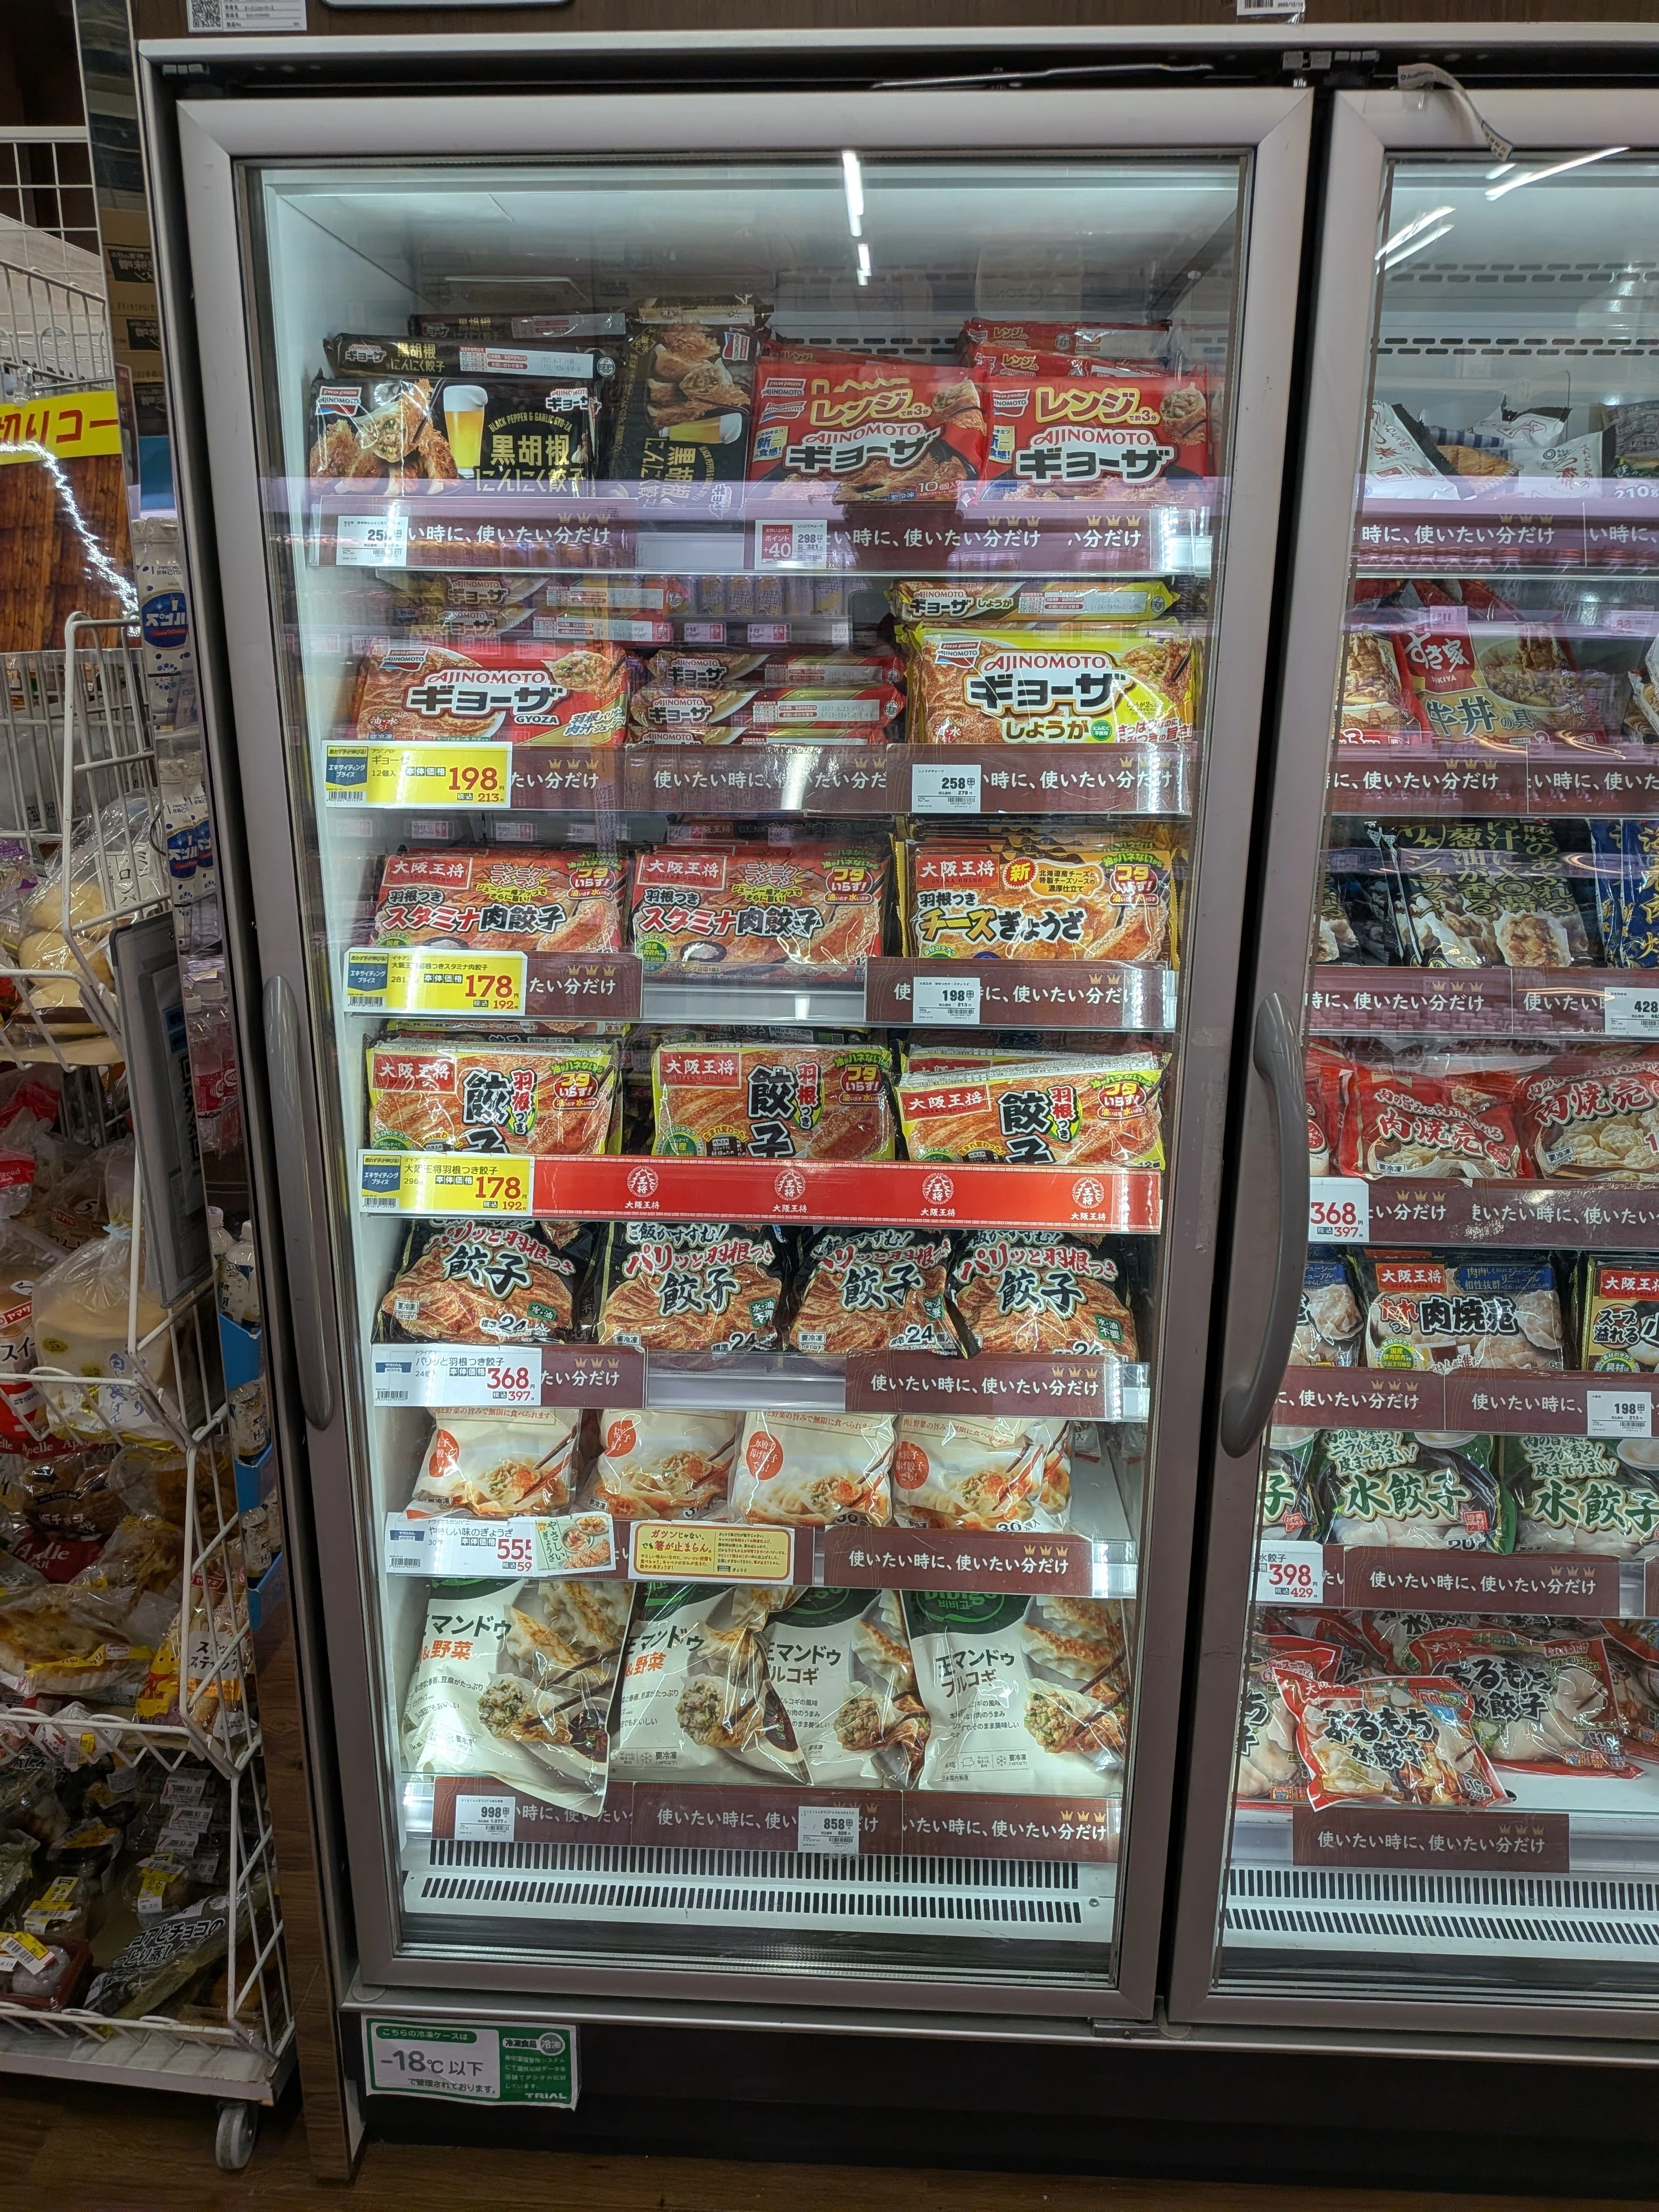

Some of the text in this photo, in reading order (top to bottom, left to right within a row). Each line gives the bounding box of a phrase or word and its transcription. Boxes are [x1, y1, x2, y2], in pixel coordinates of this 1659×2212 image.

[397, 342, 437, 360] 黒胡椒
[390, 359, 445, 373] にんにく餃子
[814, 391, 908, 425] レンジ
[900, 404, 930, 416] で約3分
[1040, 390, 1135, 422] レンジ
[488, 412, 573, 433] BLACK PEPPER & GARLIC GYO-ZA
[1128, 409, 1157, 421] で約3分
[805, 424, 921, 444] AJINOMOTO
[1034, 429, 1152, 446] AJINOMOTO
[490, 434, 570, 466] 黒胡椒
[789, 431, 937, 470] ギョーザ
[1020, 447, 1170, 480] ギョーザ
[475, 468, 586, 497] にんにく餃子
[798, 534, 816, 543] 298
[763, 542, 791, 557] +40
[977, 597, 1013, 608] しょうが
[1405, 630, 1470, 673] すき家
[984, 655, 1108, 672] AJINOMOTO
[428, 670, 545, 684] AJINOMOTO
[1431, 675, 1457, 683] SUKIYA
[410, 685, 564, 712] ギョーザ
[969, 674, 1127, 708] ギョーザ
[515, 715, 559, 724] GYOZA
[1426, 694, 1535, 738] 牛丼の具
[1004, 719, 1089, 740] しょうが
[448, 766, 498, 790] 198
[941, 777, 966, 789] 258
[478, 793, 499, 802] 213
[391, 859, 465, 877] 大阪王将
[919, 860, 995, 878] 大阪王将
[1103, 854, 1164, 867] 油がハネないから
[646, 861, 719, 879] 大阪王将
[833, 868, 864, 881] フタ
[1010, 864, 1031, 882] 新
[1039, 869, 1095, 879] 北海道産チーズと
[1117, 865, 1148, 880] フタ
[575, 878, 610, 888] いらず!
[831, 880, 867, 892] いらず!
[1039, 877, 1095, 886] 特製チーズソースの
[1048, 885, 1084, 894] 濃厚仕立て
[389, 889, 444, 904] 羽根つき
[490, 893, 530, 902] さらに旨い!
[644, 889, 700, 905] 羽根つき
[745, 893, 786, 904] さらに旨い!
[919, 893, 977, 907] 羽根つき
[384, 905, 564, 932] スタミナ肉餃子
[640, 906, 825, 938] スタミナ肉餃子
[919, 909, 1087, 942] チーズぎょうざ
[424, 974, 463, 983] 本体価格
[465, 974, 513, 998] 178
[942, 990, 965, 1001] 198
[493, 1000, 514, 1010] 192
[1634, 1000, 1658, 1013] 428
[847, 1067, 878, 1080] フタ
[846, 1081, 879, 1092] いらず!
[1537, 1078, 1649, 1125] 肉焼売
[703, 1125, 749, 1143] 生まれ変わった!
[1379, 1111, 1483, 1156] 肉焼売
[404, 1165, 498, 1175] 大阪王将羽根つき餃子
[435, 1176, 473, 1186] 本体価格
[475, 1176, 521, 1199] 178
[502, 1201, 522, 1211] 192
[772, 1204, 808, 1213] 大阪王将
[1310, 1202, 1357, 1226] 368
[628, 1224, 727, 1247] ご飯がすすむ!
[1334, 1227, 1359, 1238] 397
[625, 1242, 774, 1276] パリッと羽根つき
[961, 1242, 1118, 1282] パリッと羽根つき
[444, 1244, 529, 1298] 餃子
[660, 1268, 738, 1315] 餃子
[999, 1271, 1085, 1314] 餃子
[1380, 1298, 1419, 1322] たれ
[1420, 1296, 1517, 1335] 肉焼売
[1598, 1309, 1635, 1326] スープ
[800, 1334, 824, 1343] 要冷凍
[1593, 1326, 1639, 1344] 溢れる
[415, 1357, 505, 1366] パリッと羽根つき餃子
[449, 1368, 486, 1376] 本体価格
[487, 1368, 529, 1390] 368
[870, 1375, 1099, 1397] 使いたい時に、使いたい分だけ
[508, 1391, 531, 1401] 397
[1614, 1403, 1636, 1415] 198
[1329, 1438, 1405, 1460] ニラが香る!
[1339, 1446, 1418, 1474] 皮までうまい!
[1535, 1460, 1618, 1478] 皮までうまい!
[1342, 1469, 1470, 1517] 水餃子
[1533, 1480, 1659, 1537] 水餃子
[546, 1520, 566, 1562] やさしい
[651, 1529, 705, 1540] ガツンじゃない。
[641, 1540, 712, 1553] でも箸が止まらん。
[849, 1551, 1070, 1575] 使いたい時に、使いたい分だけ
[1269, 1563, 1312, 1587] 398
[1369, 1571, 1597, 1596] 使いたい時に、使いたい分だけ
[1290, 1587, 1313, 1598] 429
[938, 1599, 970, 1610] 비비고
[936, 1648, 1015, 1678] 王マンドゥ
[655, 1751, 677, 1761] 要冷凍
[481, 1806, 502, 1818] 998
[823, 1818, 845, 1830] 858
[1317, 1830, 1546, 1855] 使いたい時に、使いたい分だけ
[382, 2028, 468, 2041] こちらの冷凍ケースは
[505, 2038, 538, 2049] 冷凍食品
[540, 2038, 562, 2050] 冷凍
[448, 2060, 484, 2077] 以下
[408, 2077, 497, 2094] で管理されております。
